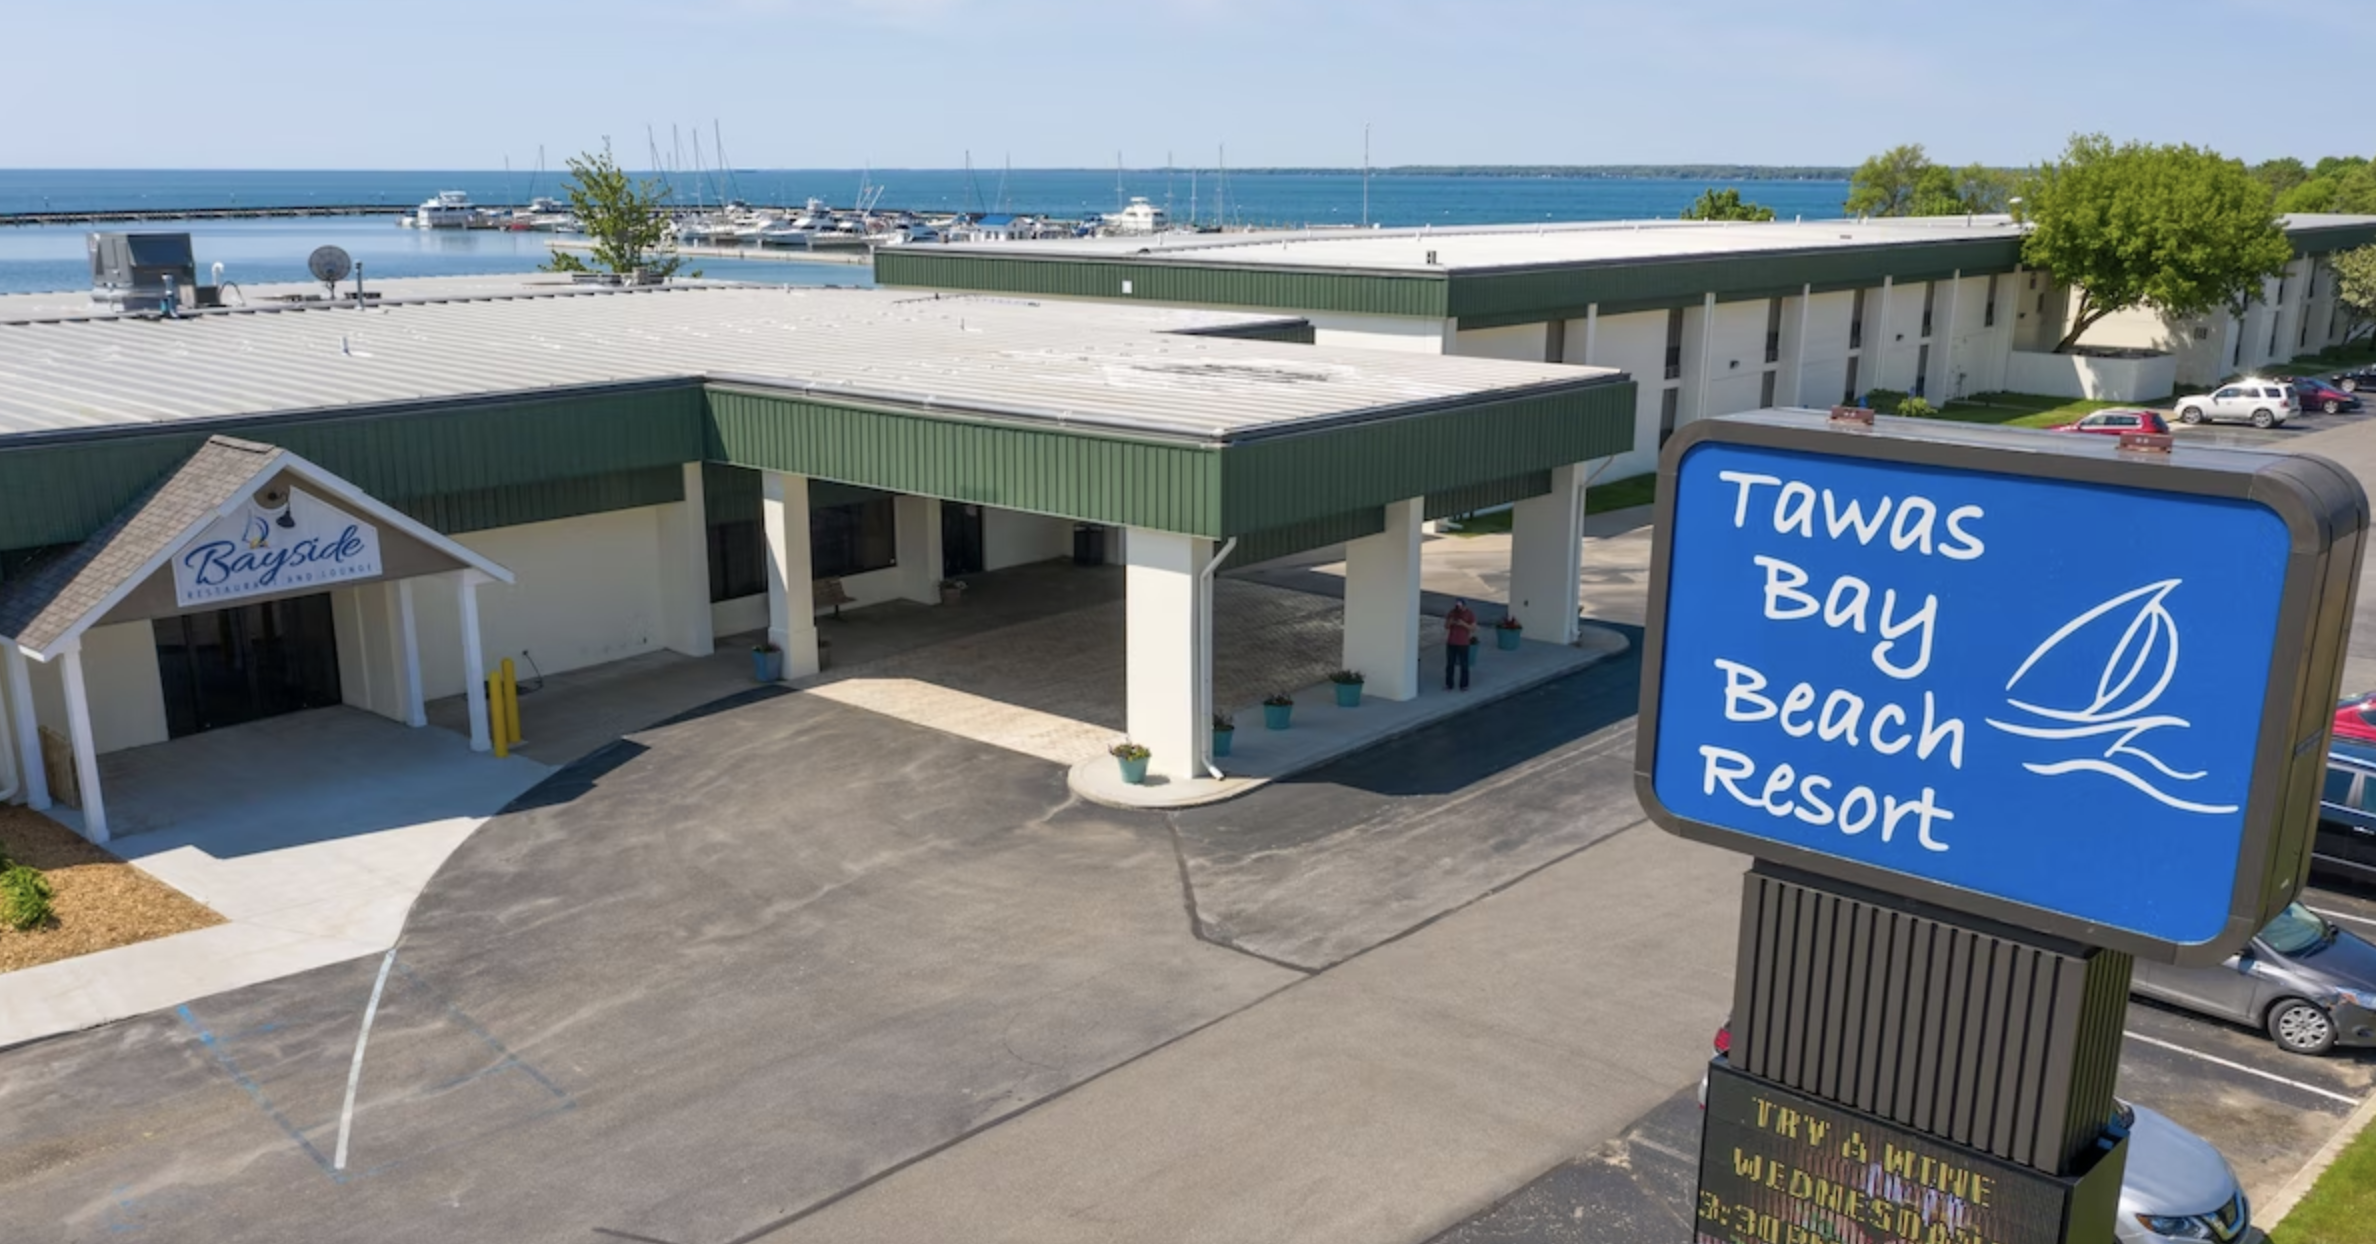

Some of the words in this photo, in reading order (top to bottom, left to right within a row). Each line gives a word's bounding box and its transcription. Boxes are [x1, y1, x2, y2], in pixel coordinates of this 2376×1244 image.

[184, 524, 365, 586] Bayside
[1719, 470, 1985, 560] Tawas
[287, 573, 313, 584] AND
[321, 563, 373, 578] LOUNGE
[1753, 555, 1938, 679] Bay
[1714, 658, 1965, 769] Beach
[1699, 745, 1955, 851] Resort
[1752, 1096, 1831, 1147] TRY
[1841, 1132, 1867, 1163] A
[1884, 1143, 1997, 1208] WINE
